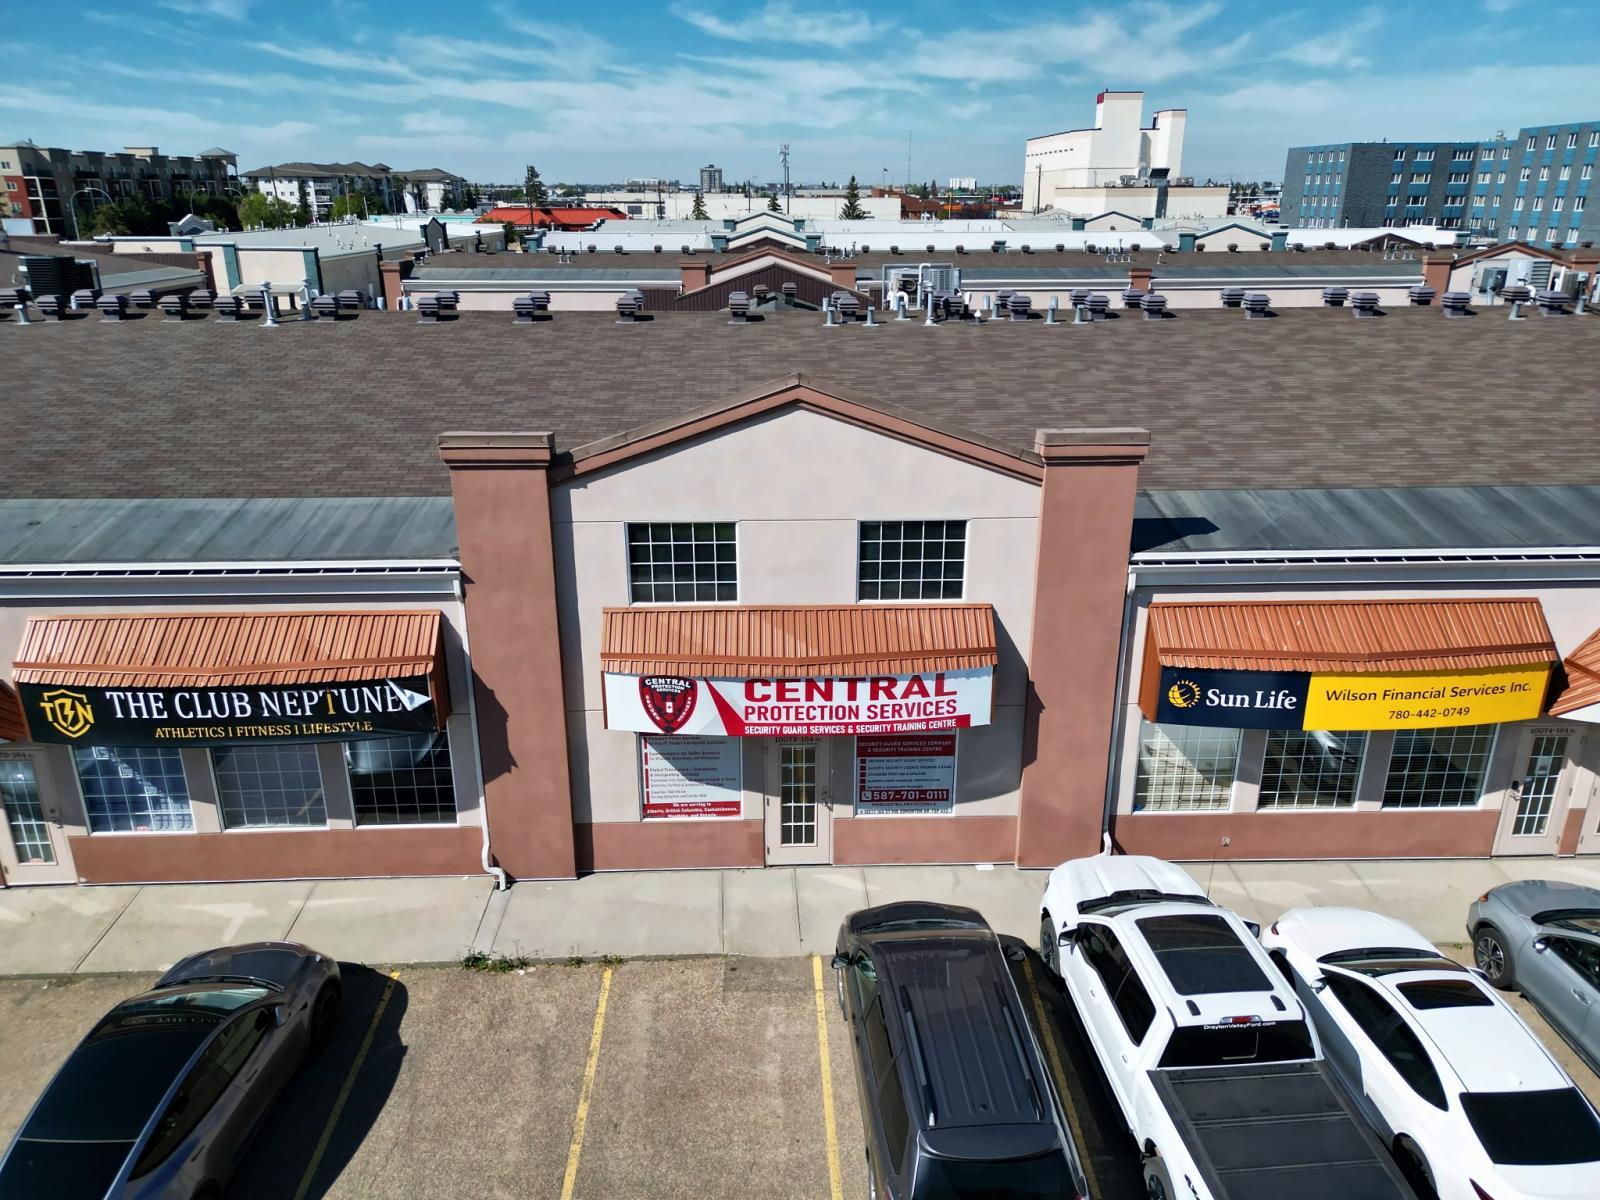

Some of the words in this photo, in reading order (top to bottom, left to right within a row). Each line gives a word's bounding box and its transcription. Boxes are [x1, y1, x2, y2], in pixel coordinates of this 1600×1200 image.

[645, 678, 691, 688] CENTRAL
[744, 673, 957, 702] CENTRAL
[1326, 689, 1377, 701] Wilson
[1382, 686, 1446, 701] Financial
[1449, 683, 1506, 698] Services
[1509, 681, 1532, 693] Inc.
[105, 691, 168, 719] THE
[174, 691, 252, 719] CLUB
[258, 685, 402, 717] NEPTUNE
[1205, 688, 1250, 708] Sun
[1253, 690, 1297, 710] Life
[744, 705, 859, 721] PROTECTION
[866, 699, 957, 720] SERVICES
[1389, 706, 1471, 720] 780-442-0749
[155, 727, 225, 738] ATHLETICS
[236, 724, 292, 737] FITNESS
[302, 721, 373, 735] LIFESTYLE
[744, 725, 781, 734] SECURITY
[782, 725, 808, 734] GUARD
[810, 725, 845, 734] SERVICES
[847, 725, 854, 733] &
[856, 724, 891, 733] SECURITY
[893, 722, 927, 732] TRAINING
[929, 719, 957, 729] CENTRE
[873, 790, 948, 800] 587-701-0111
